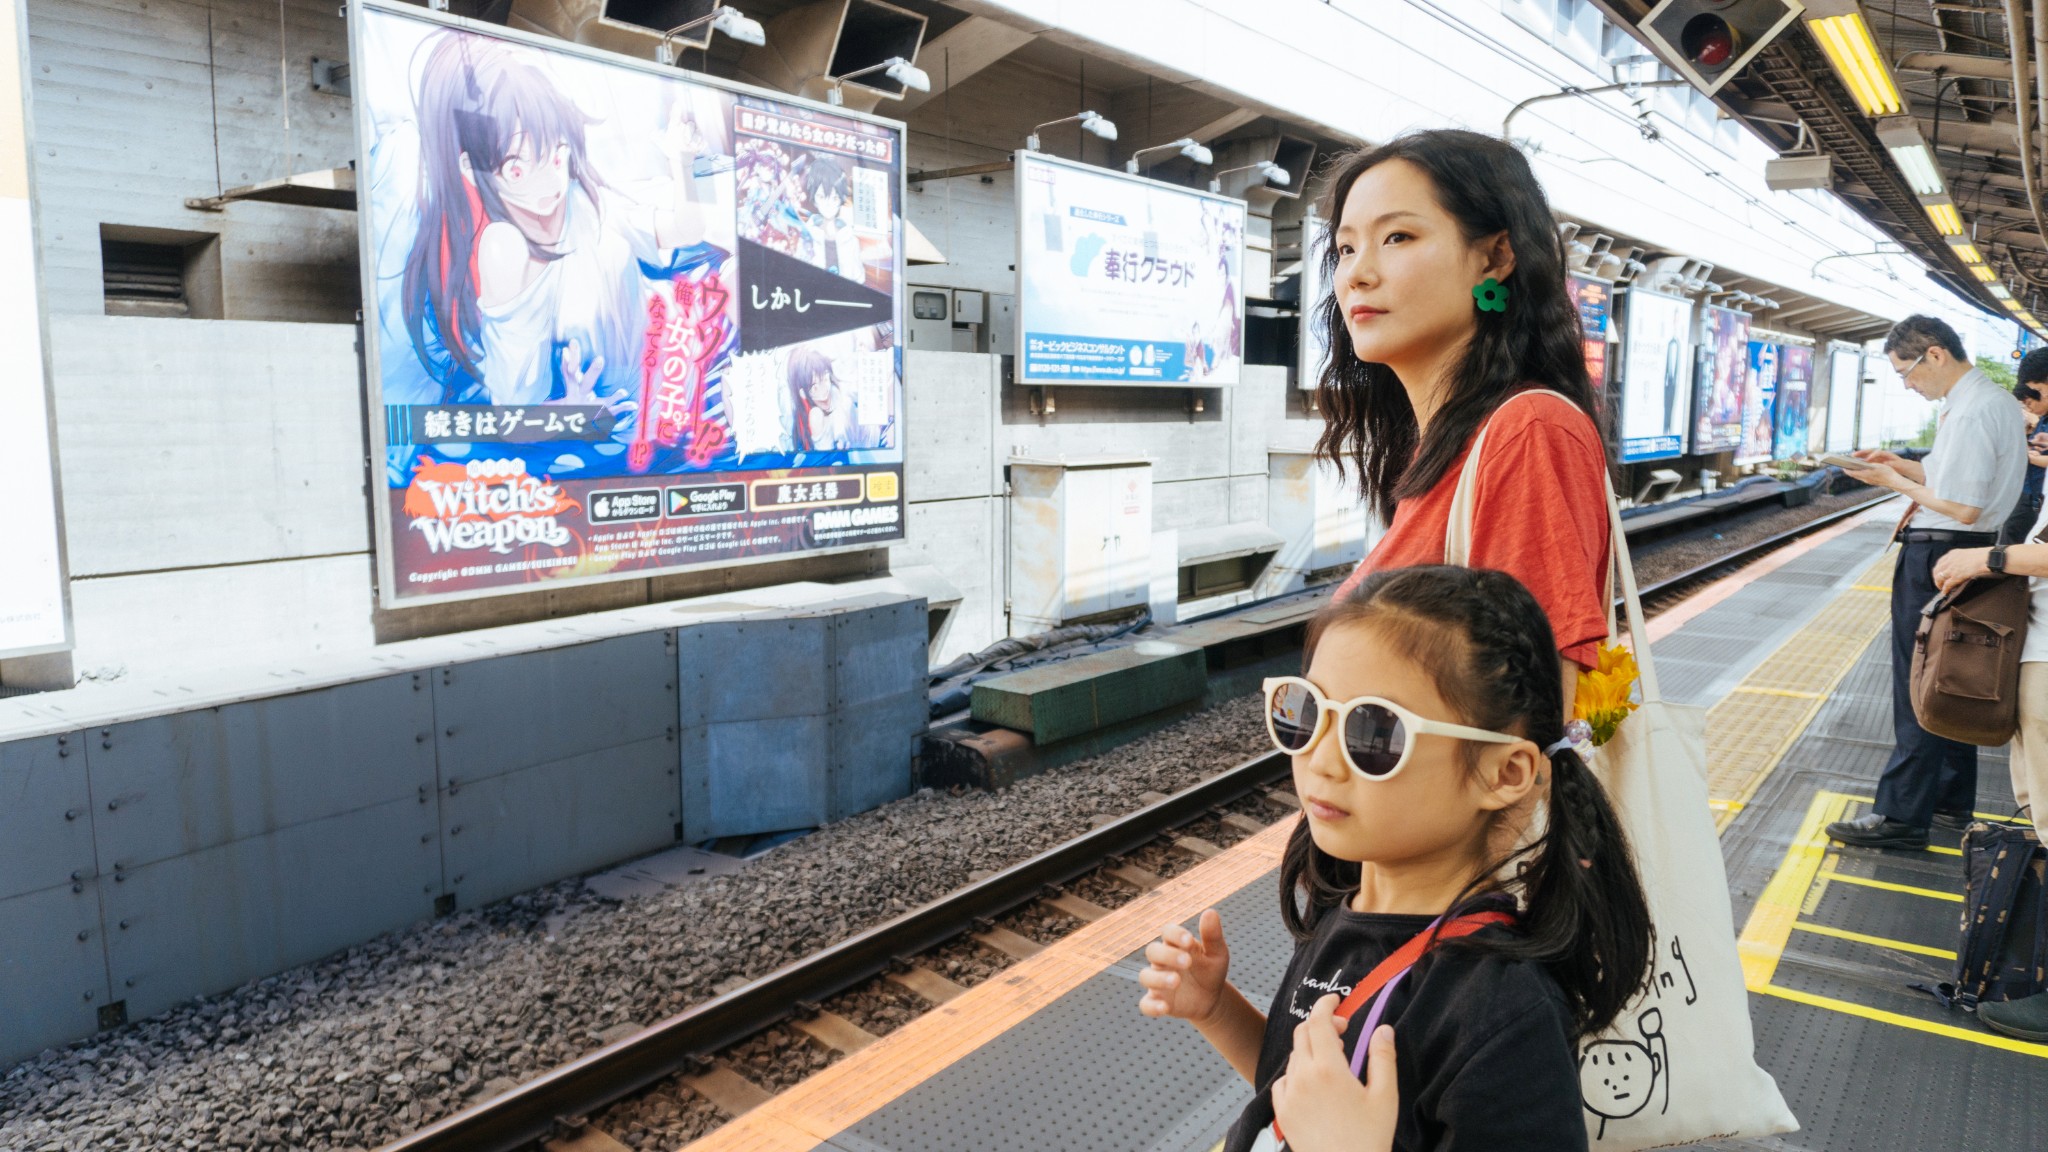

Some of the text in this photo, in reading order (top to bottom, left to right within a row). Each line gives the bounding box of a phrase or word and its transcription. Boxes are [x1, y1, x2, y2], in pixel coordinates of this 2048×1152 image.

[742, 112, 887, 157] 目が覚めたら女の子だった件
[1104, 249, 1196, 288] 奉行クラウド
[424, 408, 586, 438] 続きはゲームで
[415, 477, 560, 519] Witch's
[611, 494, 657, 509] App Store
[689, 489, 737, 504] Google Play
[777, 482, 839, 504] 魔女兵器
[611, 506, 655, 517] からダウンロード
[813, 505, 899, 530] DMM GAMES
[408, 513, 571, 554] Weapon
